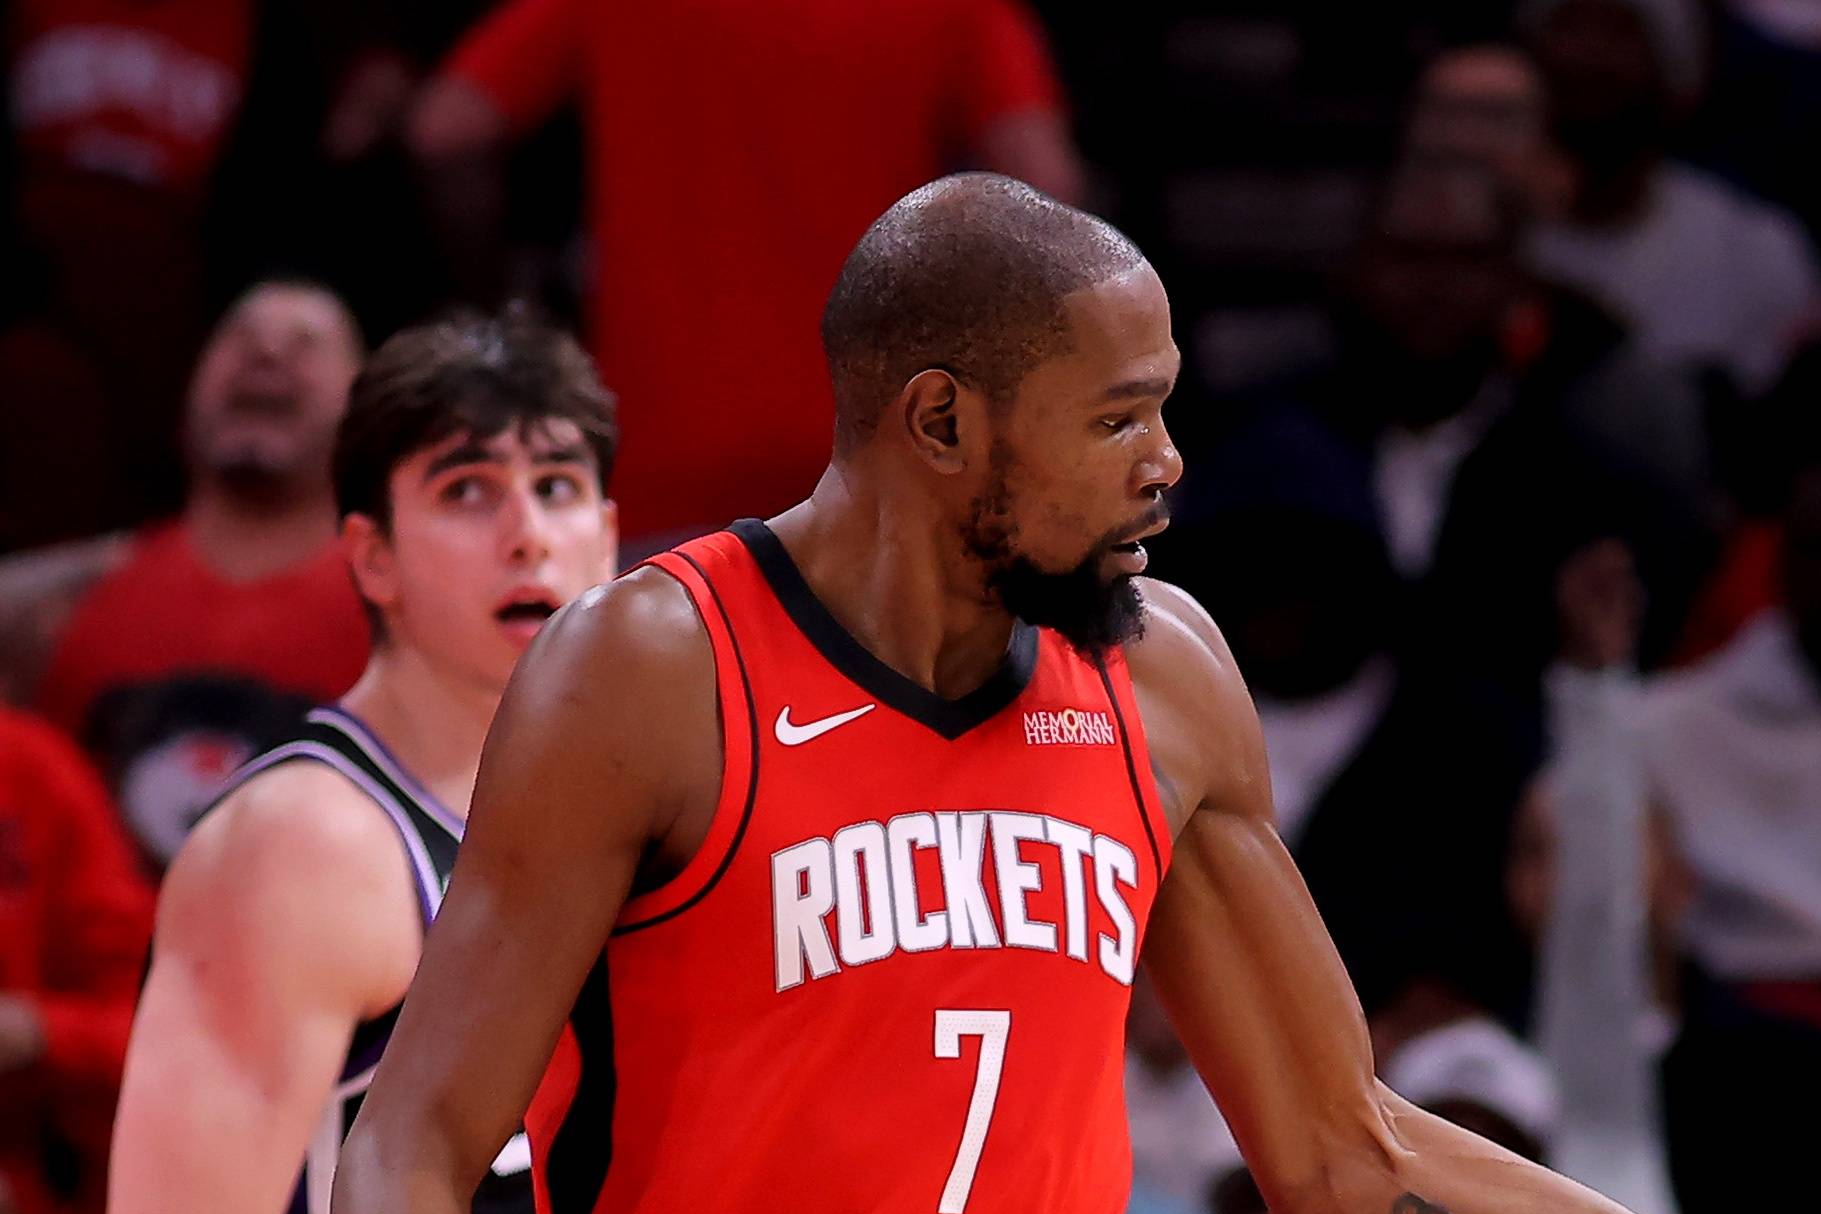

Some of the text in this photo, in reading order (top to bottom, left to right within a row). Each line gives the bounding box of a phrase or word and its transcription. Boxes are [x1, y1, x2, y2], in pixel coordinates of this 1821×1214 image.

[1023, 708, 1113, 730] MEMORIAL
[1025, 725, 1116, 745] HERMANN
[770, 810, 1139, 993] ROCKETS
